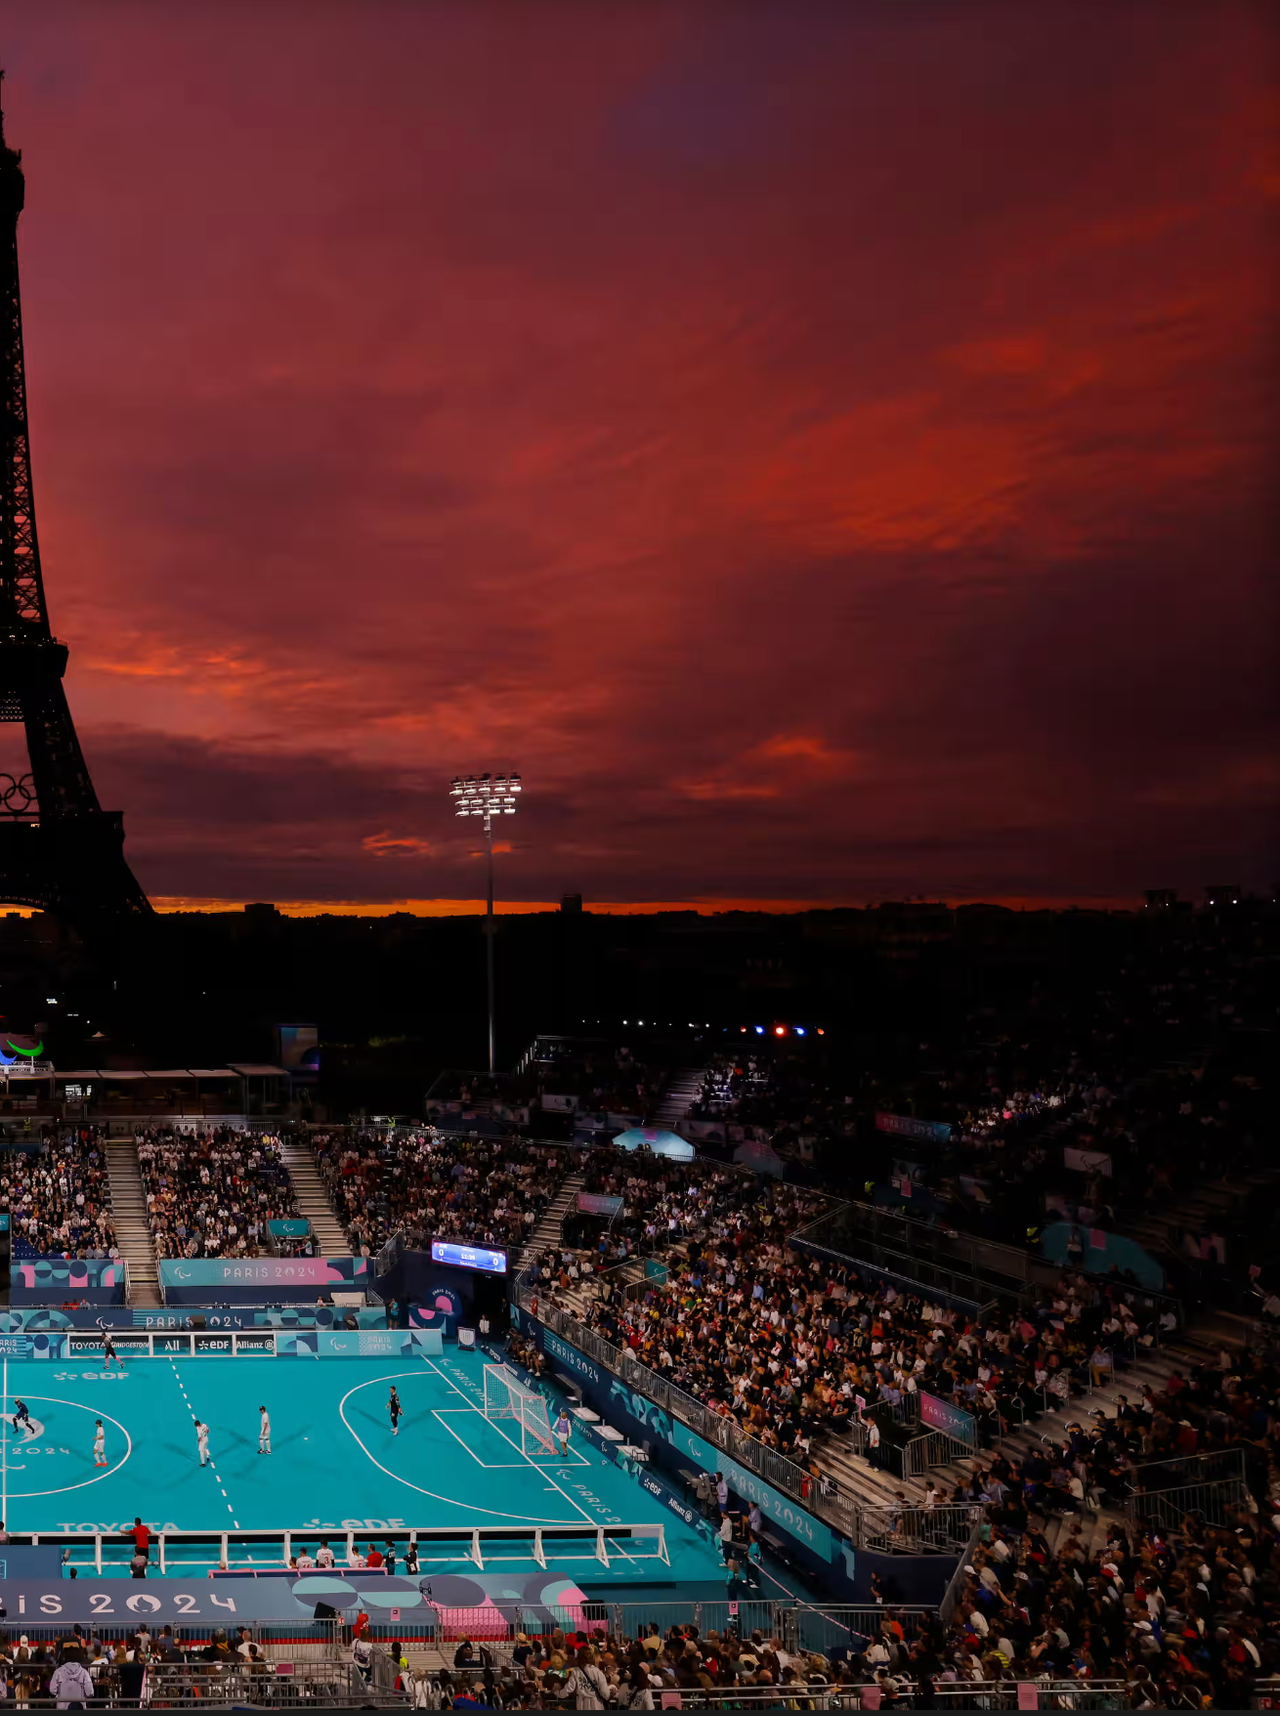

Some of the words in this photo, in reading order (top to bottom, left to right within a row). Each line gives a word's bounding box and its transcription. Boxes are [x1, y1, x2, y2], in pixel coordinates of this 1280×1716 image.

[492, 1257, 498, 1265] 0
[275, 1266, 315, 1277] 2024
[70, 1342, 105, 1350] TOYOTA
[236, 1341, 263, 1349] Allianz
[576, 1358, 599, 1382] 2024
[668, 1498, 685, 1517] Allianz
[774, 1502, 813, 1540] 2024
[57, 1522, 180, 1532] TOYOTA
[323, 1556, 329, 1565] 3
[88, 1593, 238, 1615] 2024
